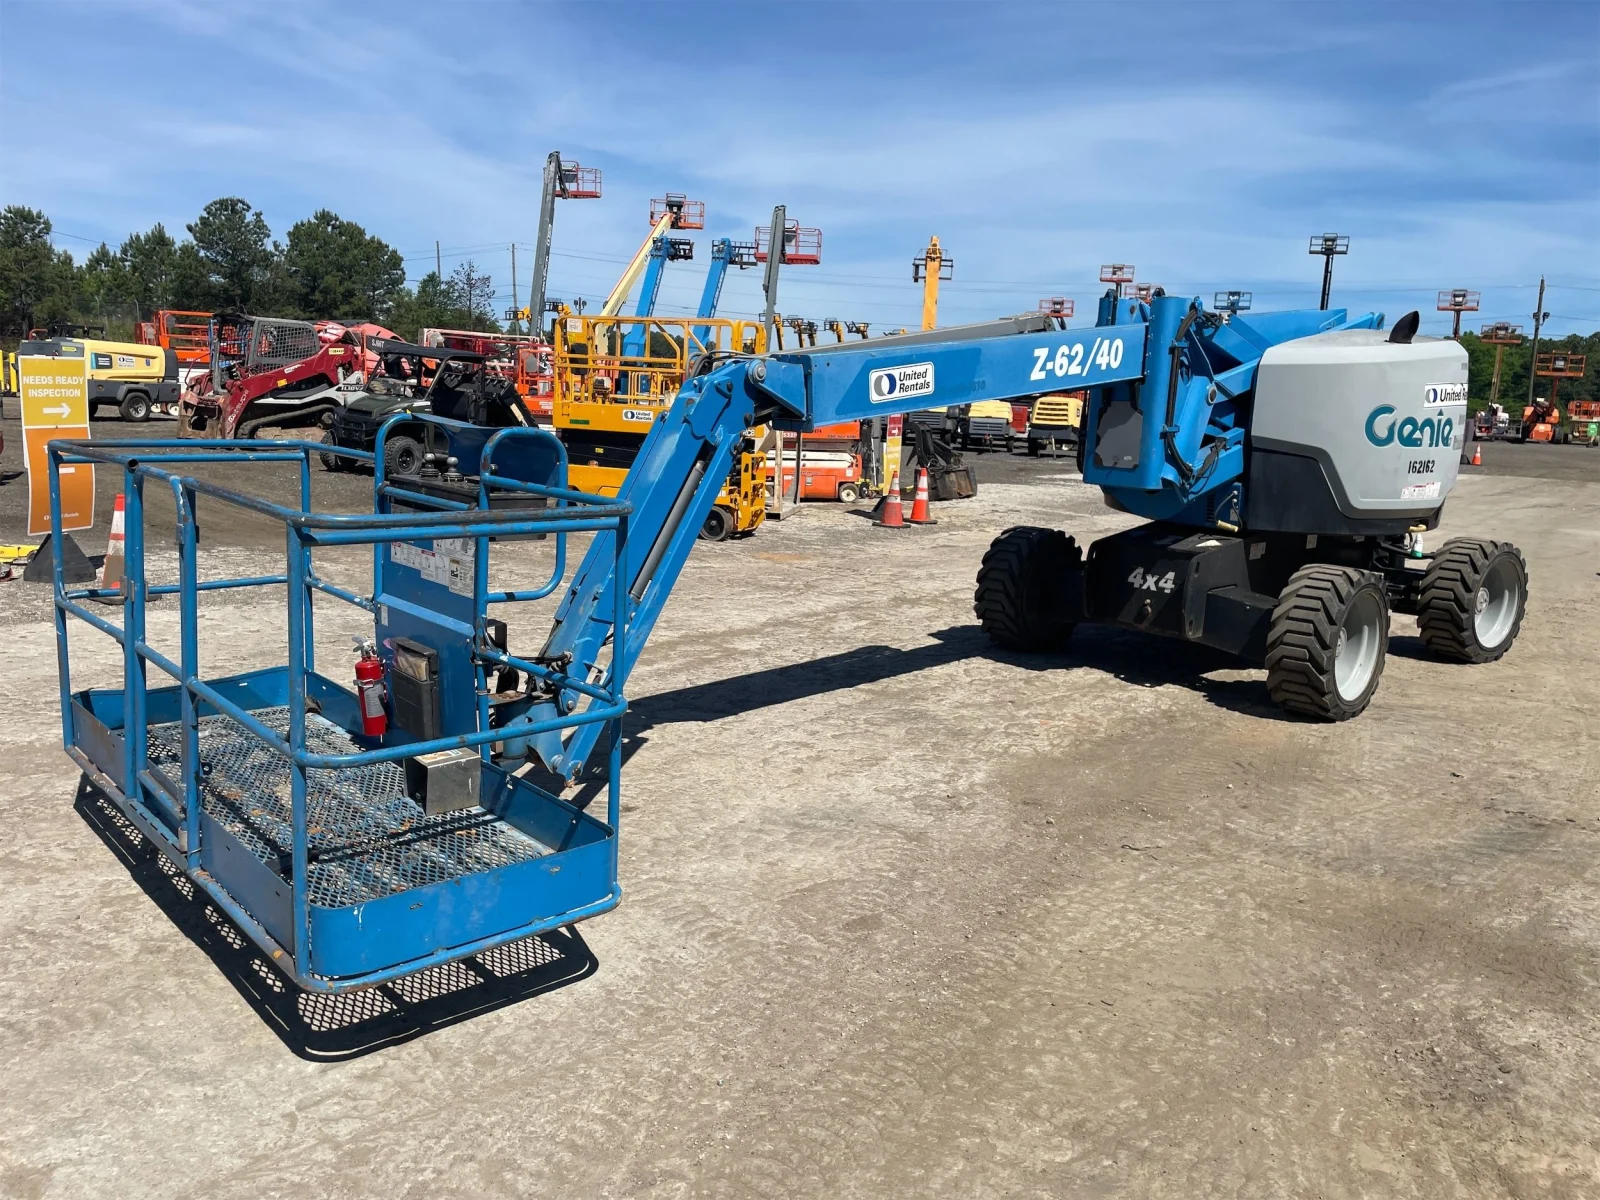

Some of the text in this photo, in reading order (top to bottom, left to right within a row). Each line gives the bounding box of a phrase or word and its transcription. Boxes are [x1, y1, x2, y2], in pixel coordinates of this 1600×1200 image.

[1030, 337, 1123, 380] Z-62/40
[22, 375, 85, 385] NEEDS READY
[899, 368, 928, 382] United
[28, 388, 81, 397] INSPECTION
[899, 380, 931, 393] Rentals
[1440, 387, 1462, 402] United
[1364, 404, 1453, 447] Genie
[1407, 459, 1436, 474] 162162
[1127, 566, 1175, 594] 4x4
